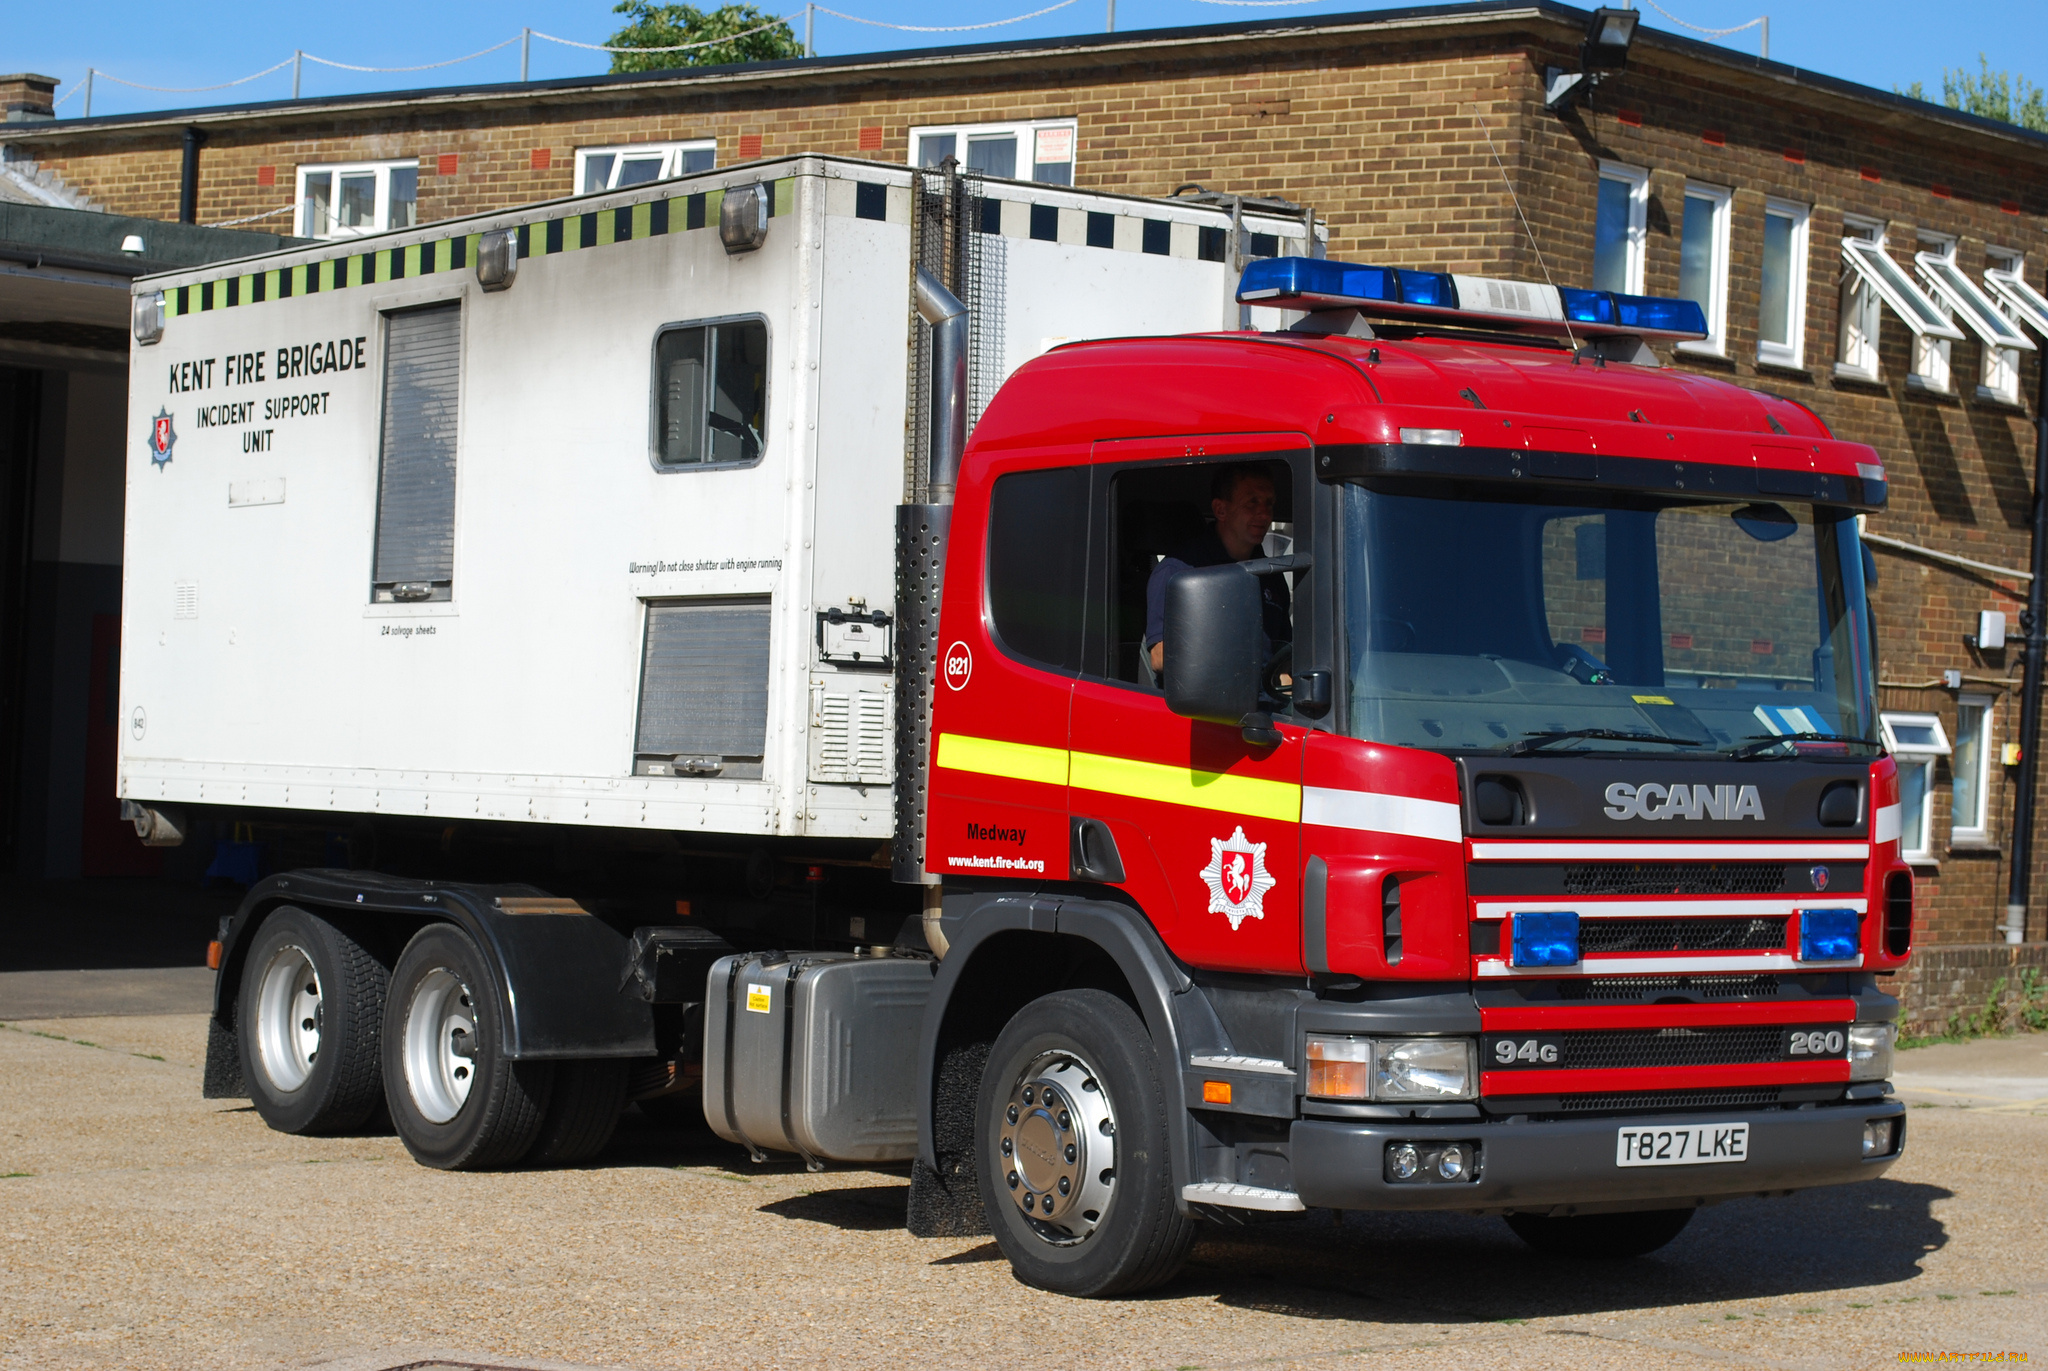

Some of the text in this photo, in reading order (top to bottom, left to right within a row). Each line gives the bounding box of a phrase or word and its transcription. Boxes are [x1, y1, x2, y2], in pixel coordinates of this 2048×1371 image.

[169, 336, 367, 394] KENT FIRE BRIGADE
[197, 392, 330, 429] INCIDENT SUPPORT
[243, 429, 274, 453] UNIT
[659, 560, 666, 572] Do
[667, 562, 677, 572] not
[679, 559, 694, 571] close
[695, 558, 719, 571] shutter
[720, 557, 735, 570] with
[736, 557, 757, 573] engine
[758, 556, 782, 572] running
[381, 625, 390, 636] 24
[415, 625, 436, 635] sheets
[948, 656, 969, 675] 821
[1603, 782, 1765, 821] SCANIA
[967, 823, 1026, 846] Medway
[947, 855, 1045, 873] www.kent.fire-uk.org
[1495, 1040, 1558, 1064] 94G
[1789, 1030, 1844, 1055] 260
[1623, 1127, 1746, 1161] T827 LKE
